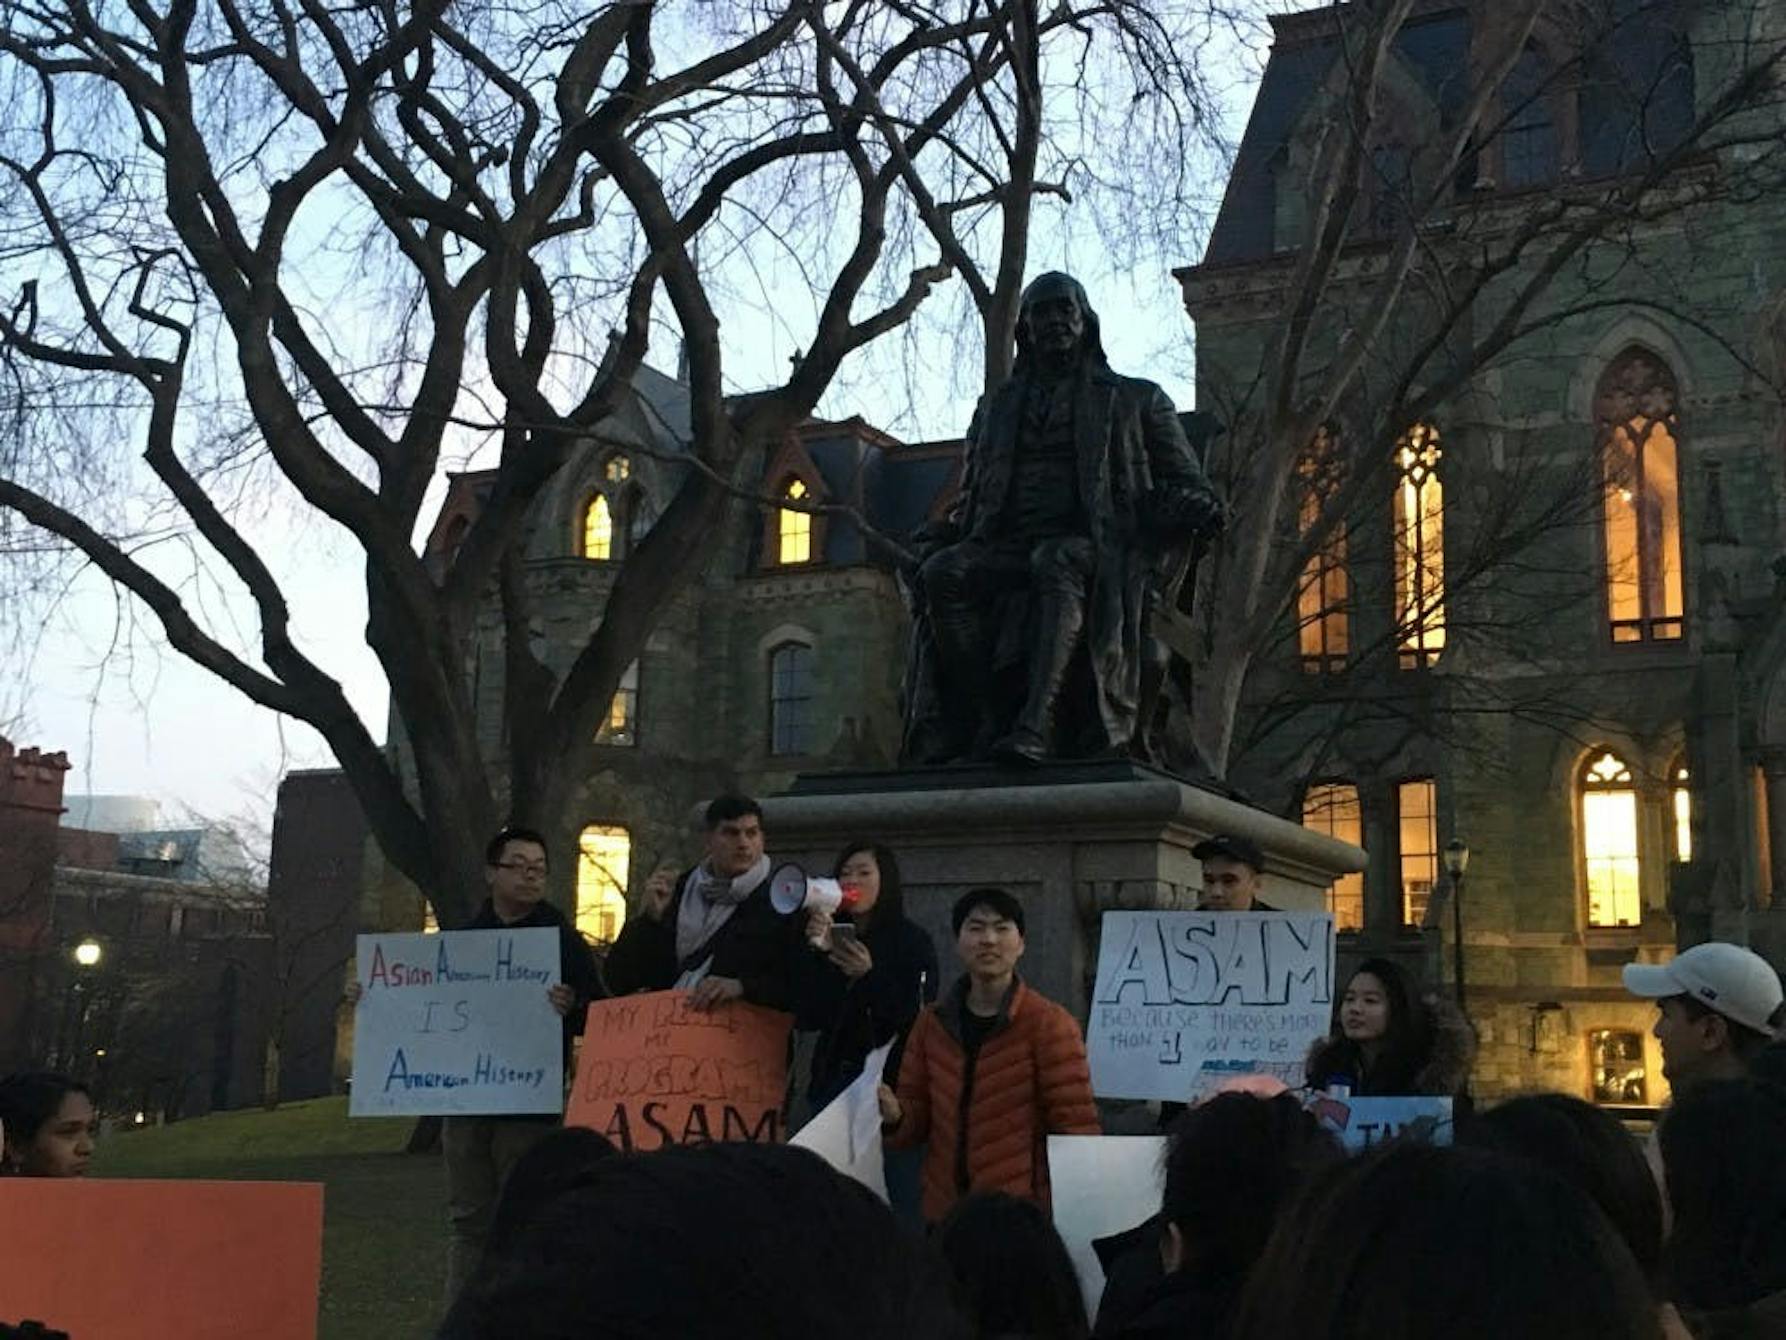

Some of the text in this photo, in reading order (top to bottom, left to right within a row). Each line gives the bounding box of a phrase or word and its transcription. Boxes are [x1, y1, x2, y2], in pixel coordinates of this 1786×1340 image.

[369, 943, 432, 989] Asian
[1098, 917, 1332, 1006] ASAM
[418, 1000, 470, 1034] IS
[384, 1047, 469, 1092] American
[604, 1102, 782, 1149] ASAM
